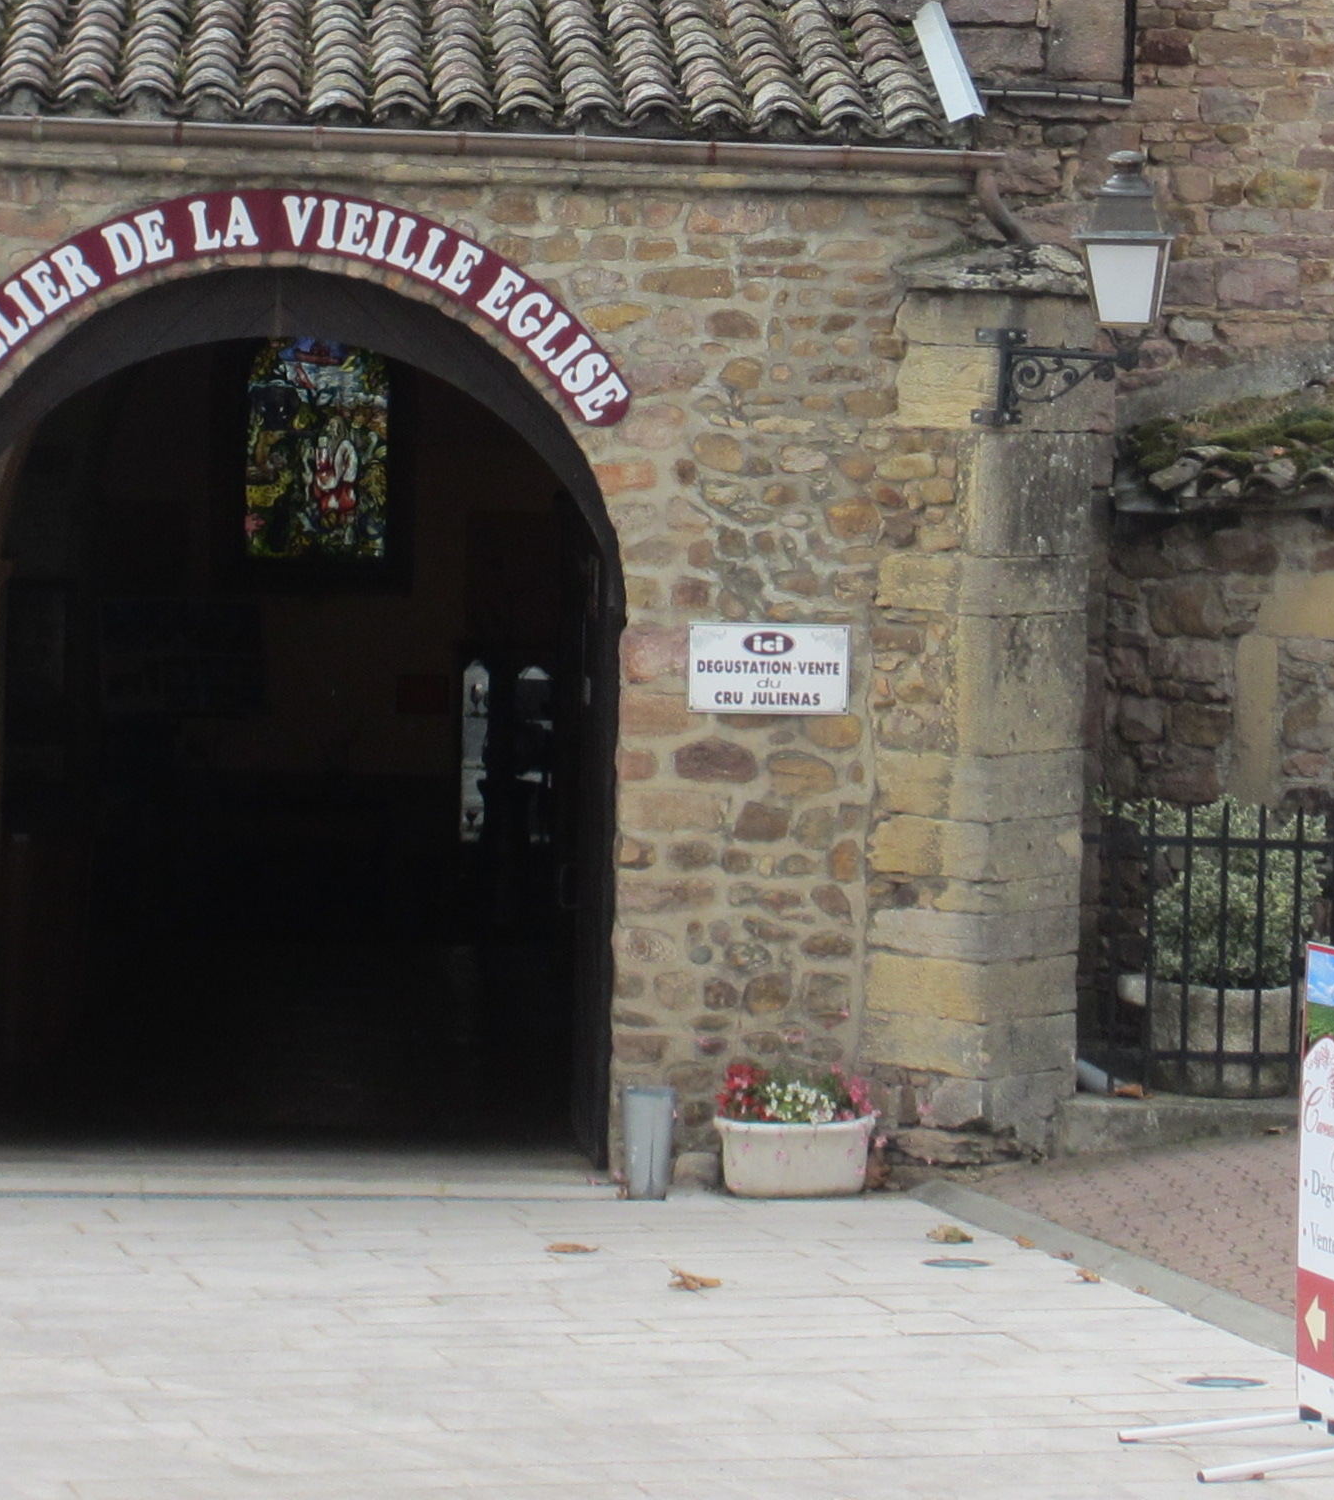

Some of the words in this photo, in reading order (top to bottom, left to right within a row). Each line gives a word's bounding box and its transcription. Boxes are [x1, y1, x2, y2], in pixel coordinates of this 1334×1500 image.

[102, 208, 174, 275] DE
[188, 195, 259, 250] LA
[283, 194, 484, 295] VIEILLE
[477, 266, 629, 422] EGLISE
[753, 635, 784, 651] ici
[757, 678, 781, 688] du
[715, 691, 743, 705] CRU
[750, 692, 821, 706] JULIENAS
